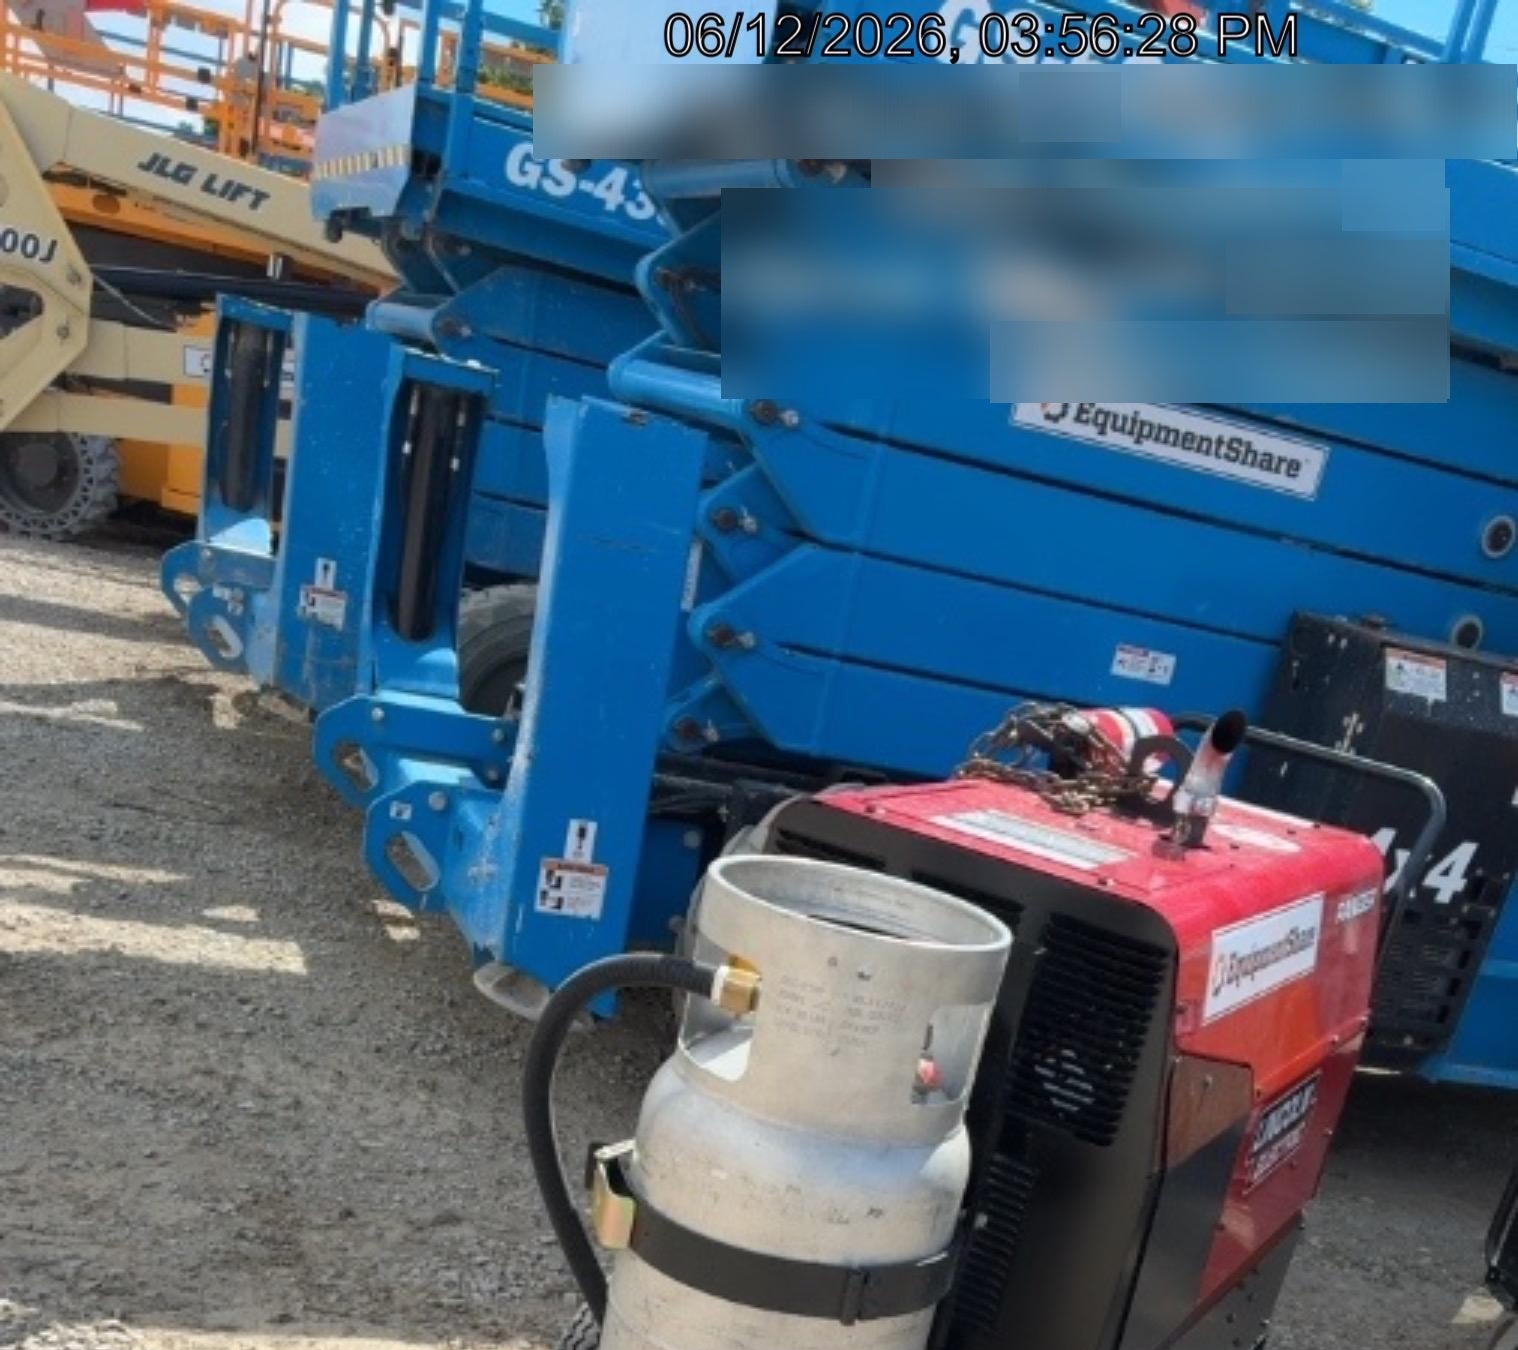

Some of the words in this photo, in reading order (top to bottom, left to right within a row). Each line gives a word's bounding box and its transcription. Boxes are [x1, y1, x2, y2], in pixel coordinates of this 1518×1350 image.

[137, 152, 199, 186] JLG
[201, 173, 271, 211] LIFT
[1073, 402, 1302, 478] EquipmentShare
